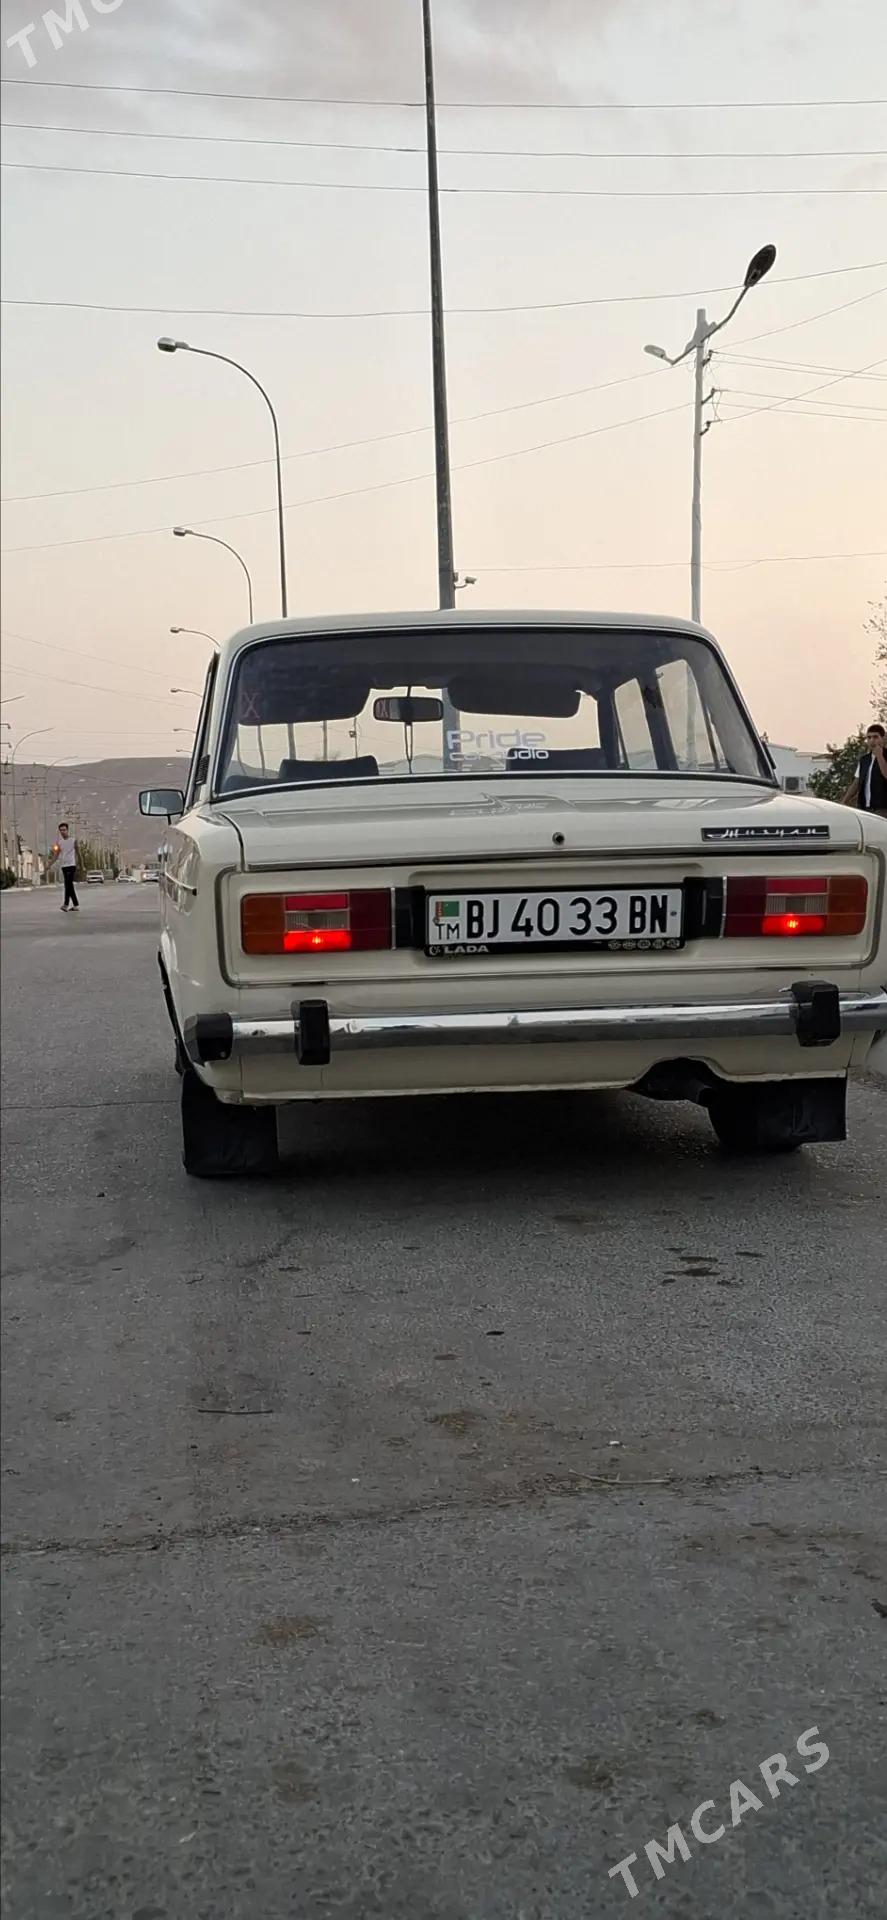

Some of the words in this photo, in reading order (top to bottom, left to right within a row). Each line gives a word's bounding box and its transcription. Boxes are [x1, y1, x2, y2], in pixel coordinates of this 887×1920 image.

[446, 729, 546, 749] Pride
[466, 899, 500, 939] BJ
[629, 894, 668, 935] BN
[435, 923, 460, 940] TM
[444, 945, 490, 954] LADA
